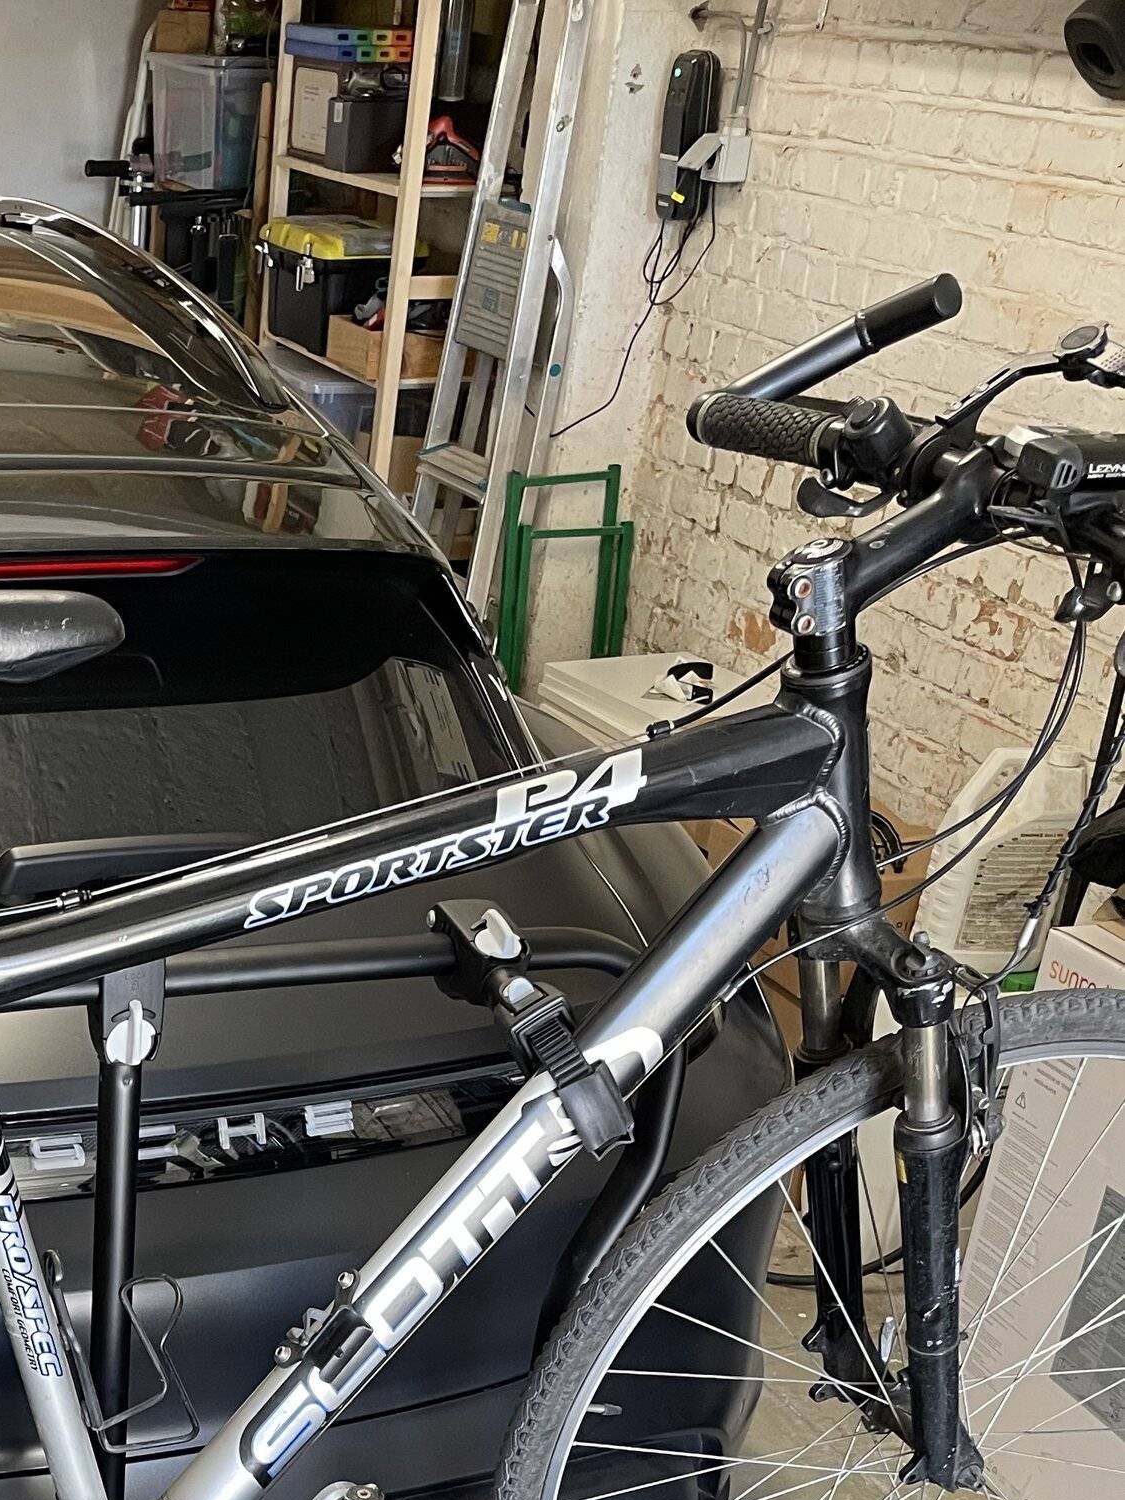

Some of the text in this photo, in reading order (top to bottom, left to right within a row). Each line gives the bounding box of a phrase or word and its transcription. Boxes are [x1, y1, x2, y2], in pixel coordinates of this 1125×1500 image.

[494, 748, 647, 825] P4
[244, 795, 610, 930] SPORTSTER
[1, 1268, 39, 1371] COMFORT GEOMETRY
